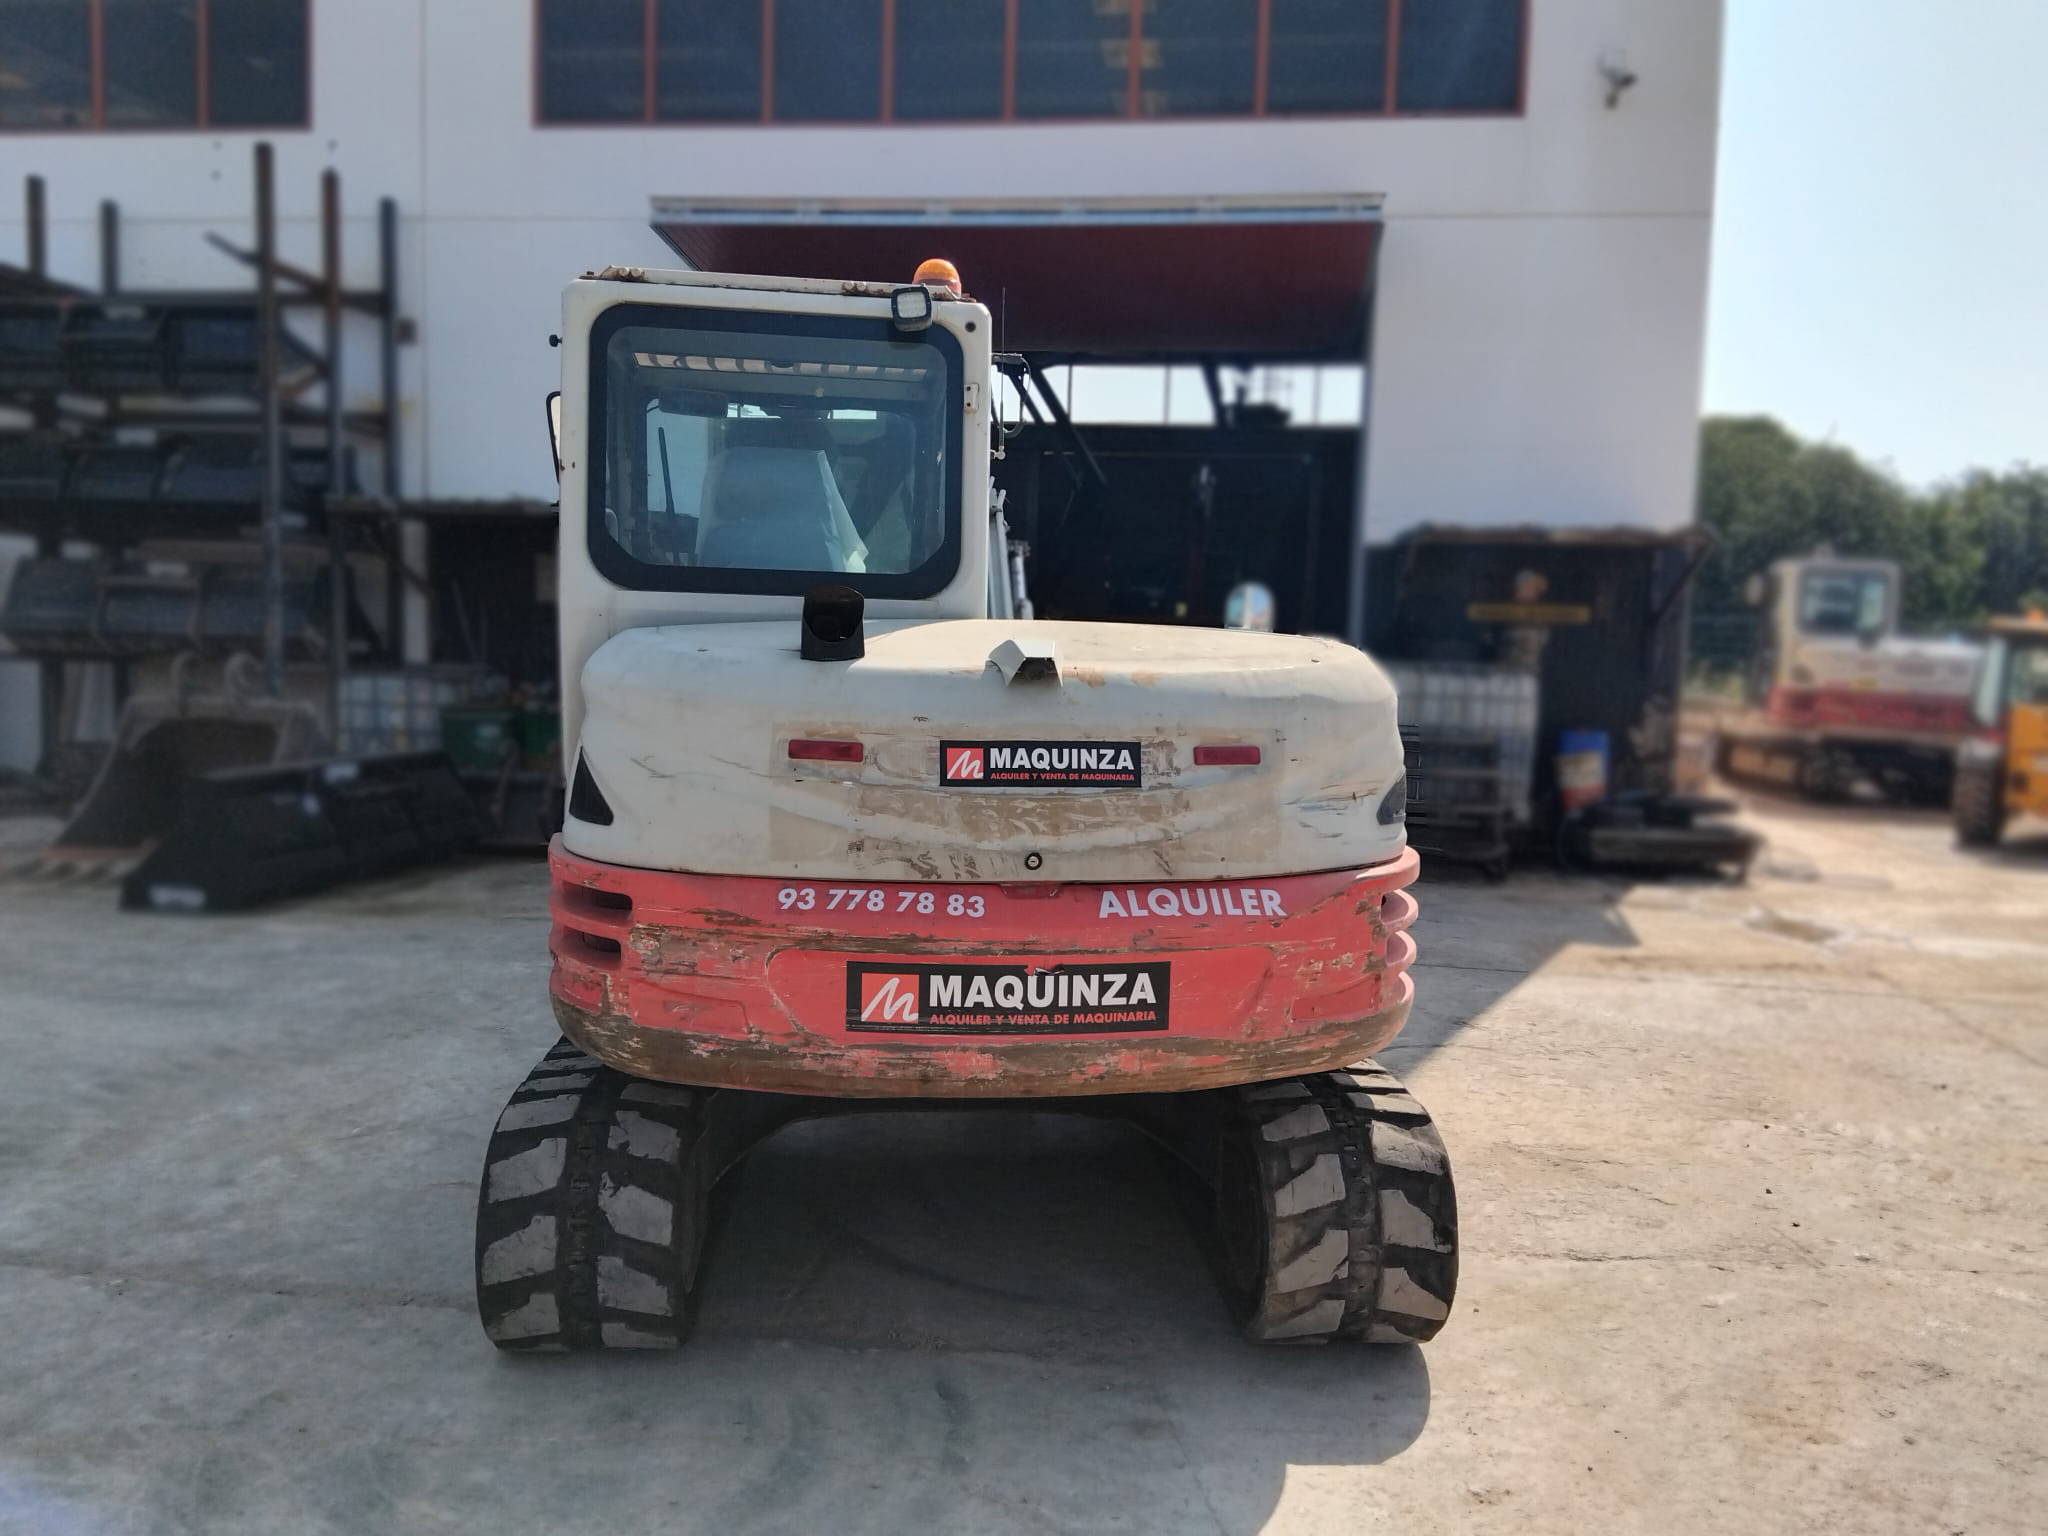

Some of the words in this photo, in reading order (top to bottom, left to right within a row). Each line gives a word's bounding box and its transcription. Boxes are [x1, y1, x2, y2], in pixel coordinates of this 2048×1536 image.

[990, 748, 1135, 771] MAQUINZA
[990, 772, 1029, 780] ALQUILER
[1081, 773, 1135, 781] MAQUINARIA
[778, 888, 815, 910] 93
[826, 889, 885, 912] 778
[896, 891, 935, 914] 78
[946, 894, 985, 918] 83
[1099, 887, 1288, 919] ALQUILER
[929, 973, 1157, 1010] MAQUINZA
[929, 1014, 991, 1025] ALQUILER
[995, 1014, 1004, 1025] Y
[1008, 1014, 1050, 1025] VENTA
[1054, 1014, 1069, 1024] DE
[1073, 1011, 1156, 1024] MAQUINARIA
